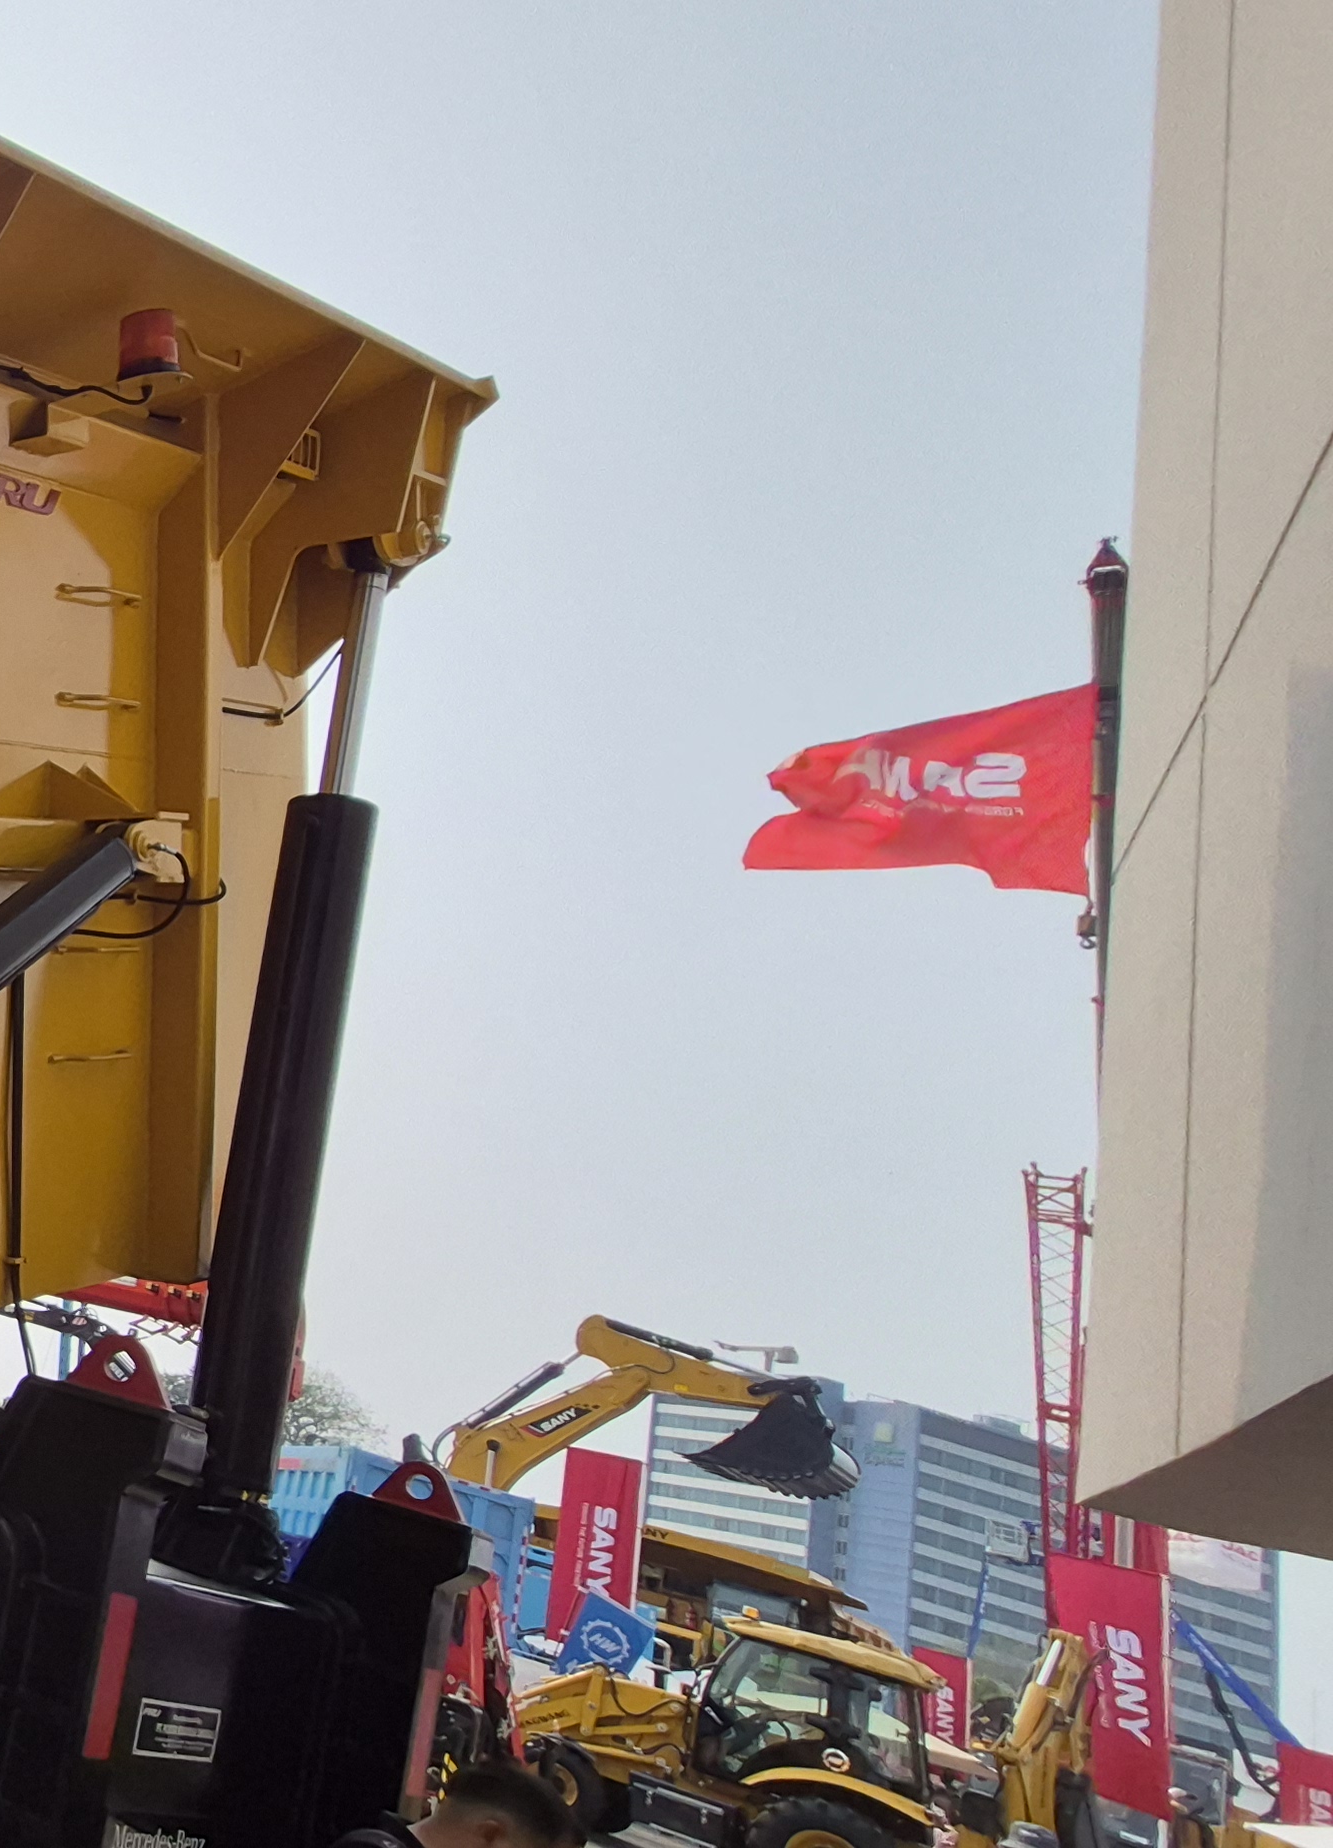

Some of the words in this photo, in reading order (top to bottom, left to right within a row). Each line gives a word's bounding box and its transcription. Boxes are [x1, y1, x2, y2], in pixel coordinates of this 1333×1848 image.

[539, 1407, 577, 1432] SANY
[586, 1506, 617, 1598] SANY
[1105, 1625, 1151, 1747] SANY
[113, 1824, 206, 1848] Mercedes-Benz
